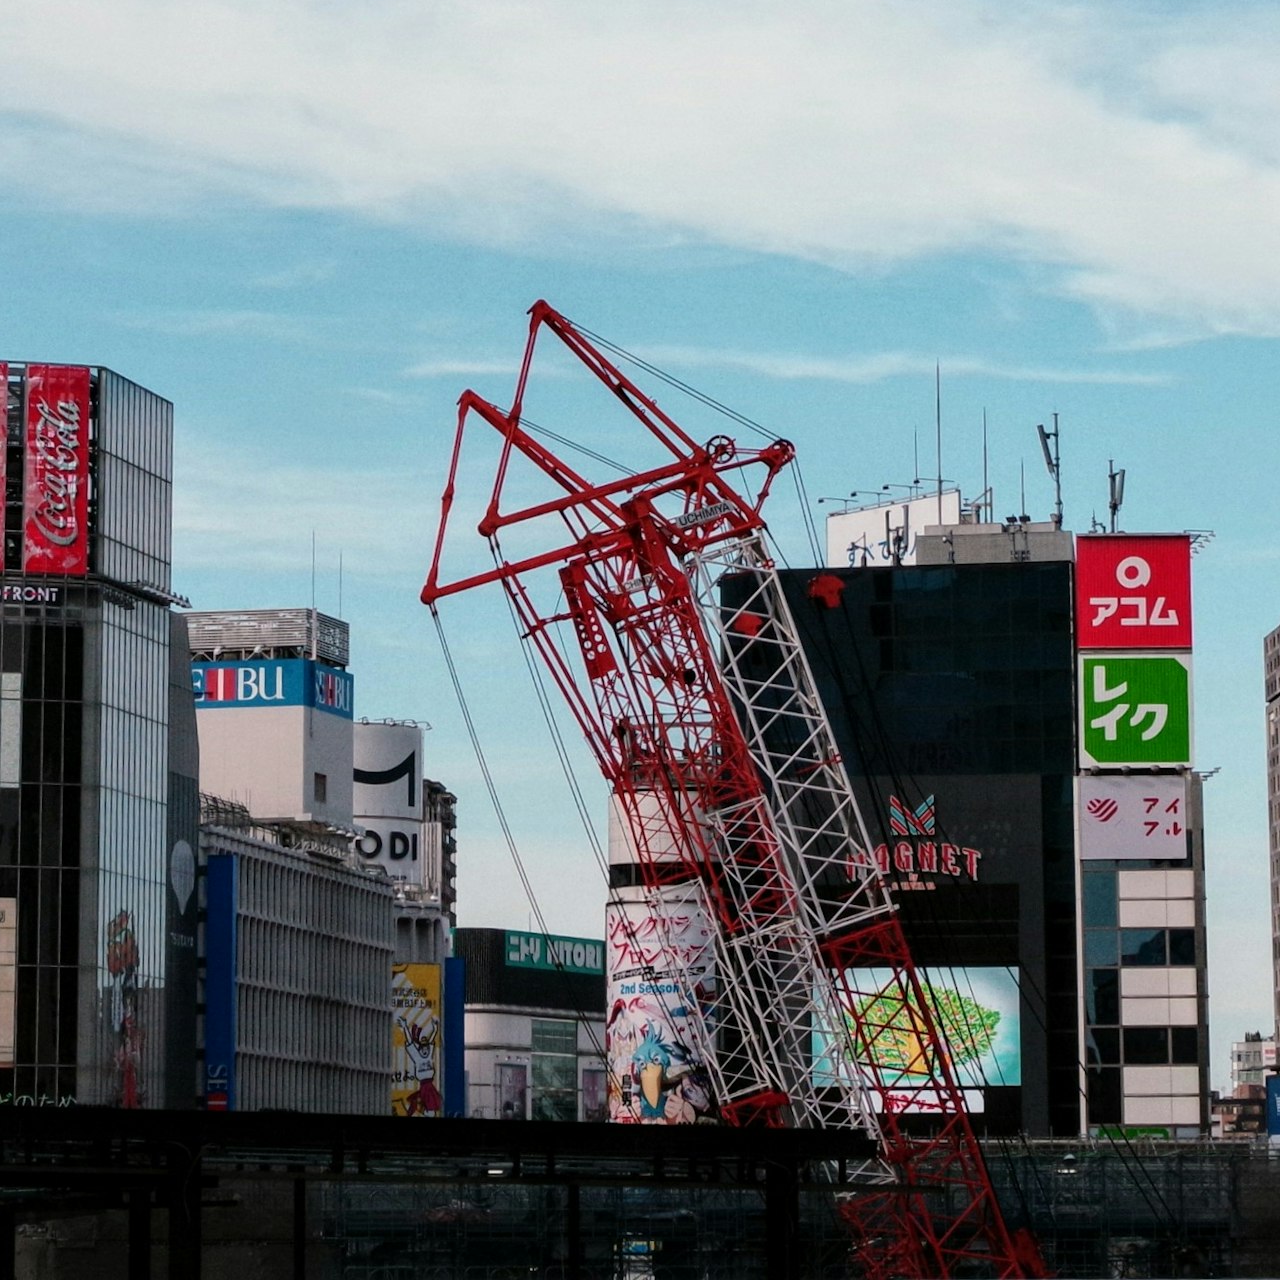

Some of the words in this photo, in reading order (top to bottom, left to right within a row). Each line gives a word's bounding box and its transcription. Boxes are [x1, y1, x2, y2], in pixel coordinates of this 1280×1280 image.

[678, 502, 731, 526] UCHIMIYA
[1089, 596, 1179, 626] アコム
[315, 672, 351, 712] SEIBU
[845, 841, 982, 884] MAGNET
[508, 935, 541, 963] ニトリ
[546, 939, 603, 969] NITORI
[620, 983, 636, 995] 2nd
[639, 982, 680, 994] Season
